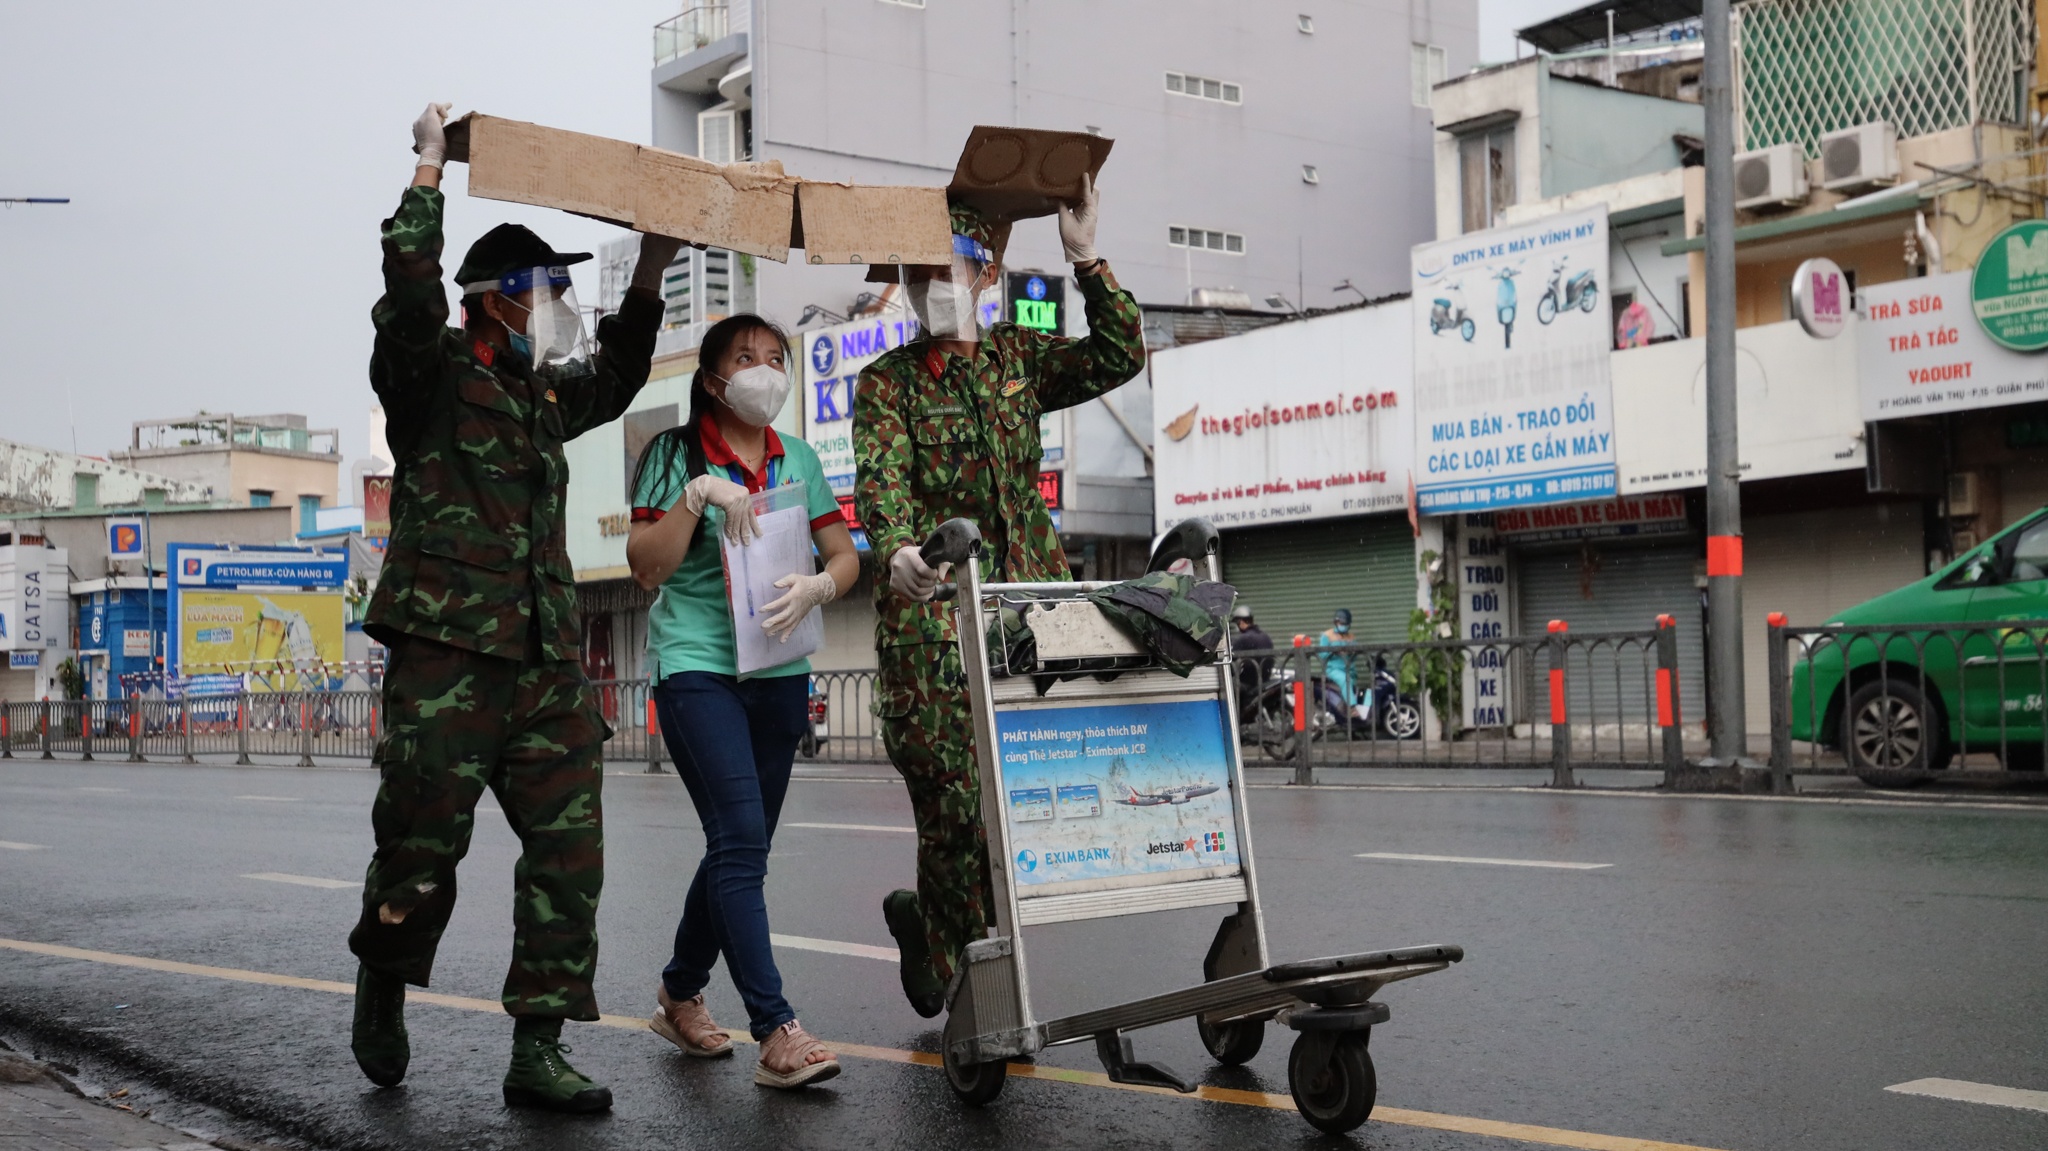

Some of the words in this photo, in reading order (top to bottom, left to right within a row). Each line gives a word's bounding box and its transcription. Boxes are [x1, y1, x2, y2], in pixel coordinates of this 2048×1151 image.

[1453, 248, 1485, 266] DNTN
[1489, 243, 1505, 258] XE
[1509, 233, 1536, 253] MÁY
[1015, 299, 1056, 330] KIM
[1870, 301, 1900, 320] TRÀ
[1908, 293, 1943, 315] SỮA
[842, 320, 887, 359] NHÀ
[1889, 332, 1921, 352] TRÀ
[1908, 362, 1973, 385] YAOURT
[1893, 395, 1922, 407] HOÀNG
[1926, 390, 1943, 403] VĂN
[1947, 389, 1965, 401] THỤ
[1996, 381, 2022, 395] QUẬN
[1201, 390, 1398, 436] thegioisonmoi.com
[1432, 422, 1465, 442] MUA
[1470, 412, 1503, 437] BÁN
[1517, 407, 1561, 432] TRAO
[1566, 392, 1596, 423] ĐỔI
[1428, 448, 1460, 473] CÁC
[1464, 448, 1501, 473] LOẠI
[1506, 444, 1526, 466] XE
[1532, 431, 1567, 461] GẮN
[1573, 428, 1610, 455] MÁY
[1325, 473, 1356, 487] chính
[1497, 508, 1530, 531] CỬA
[1532, 504, 1578, 528] HÀNG
[1581, 503, 1602, 523] XE
[298, 566, 321, 578] HÀNG
[324, 570, 333, 578] 08
[1465, 566, 1504, 584] TRAO
[25, 571, 40, 641] CATSA
[1472, 589, 1498, 612] ĐỔI
[1471, 619, 1502, 639] CÁC
[12, 653, 39, 663] CATSA
[1480, 679, 1497, 696] XE
[1003, 729, 1028, 743] PHÁT
[1030, 728, 1058, 741] HÀNH
[1060, 730, 1084, 742] ngay,
[1085, 726, 1105, 738] thỏa
[1107, 725, 1129, 736] thích
[1130, 724, 1147, 735] BAY
[1005, 751, 1028, 764] cùng
[1047, 749, 1077, 760] Jetstar
[1086, 744, 1129, 757] Eximbank
[1131, 743, 1146, 755] JCB
[1045, 847, 1111, 866] EXIMBANK
[1147, 842, 1185, 856] Jetstar
